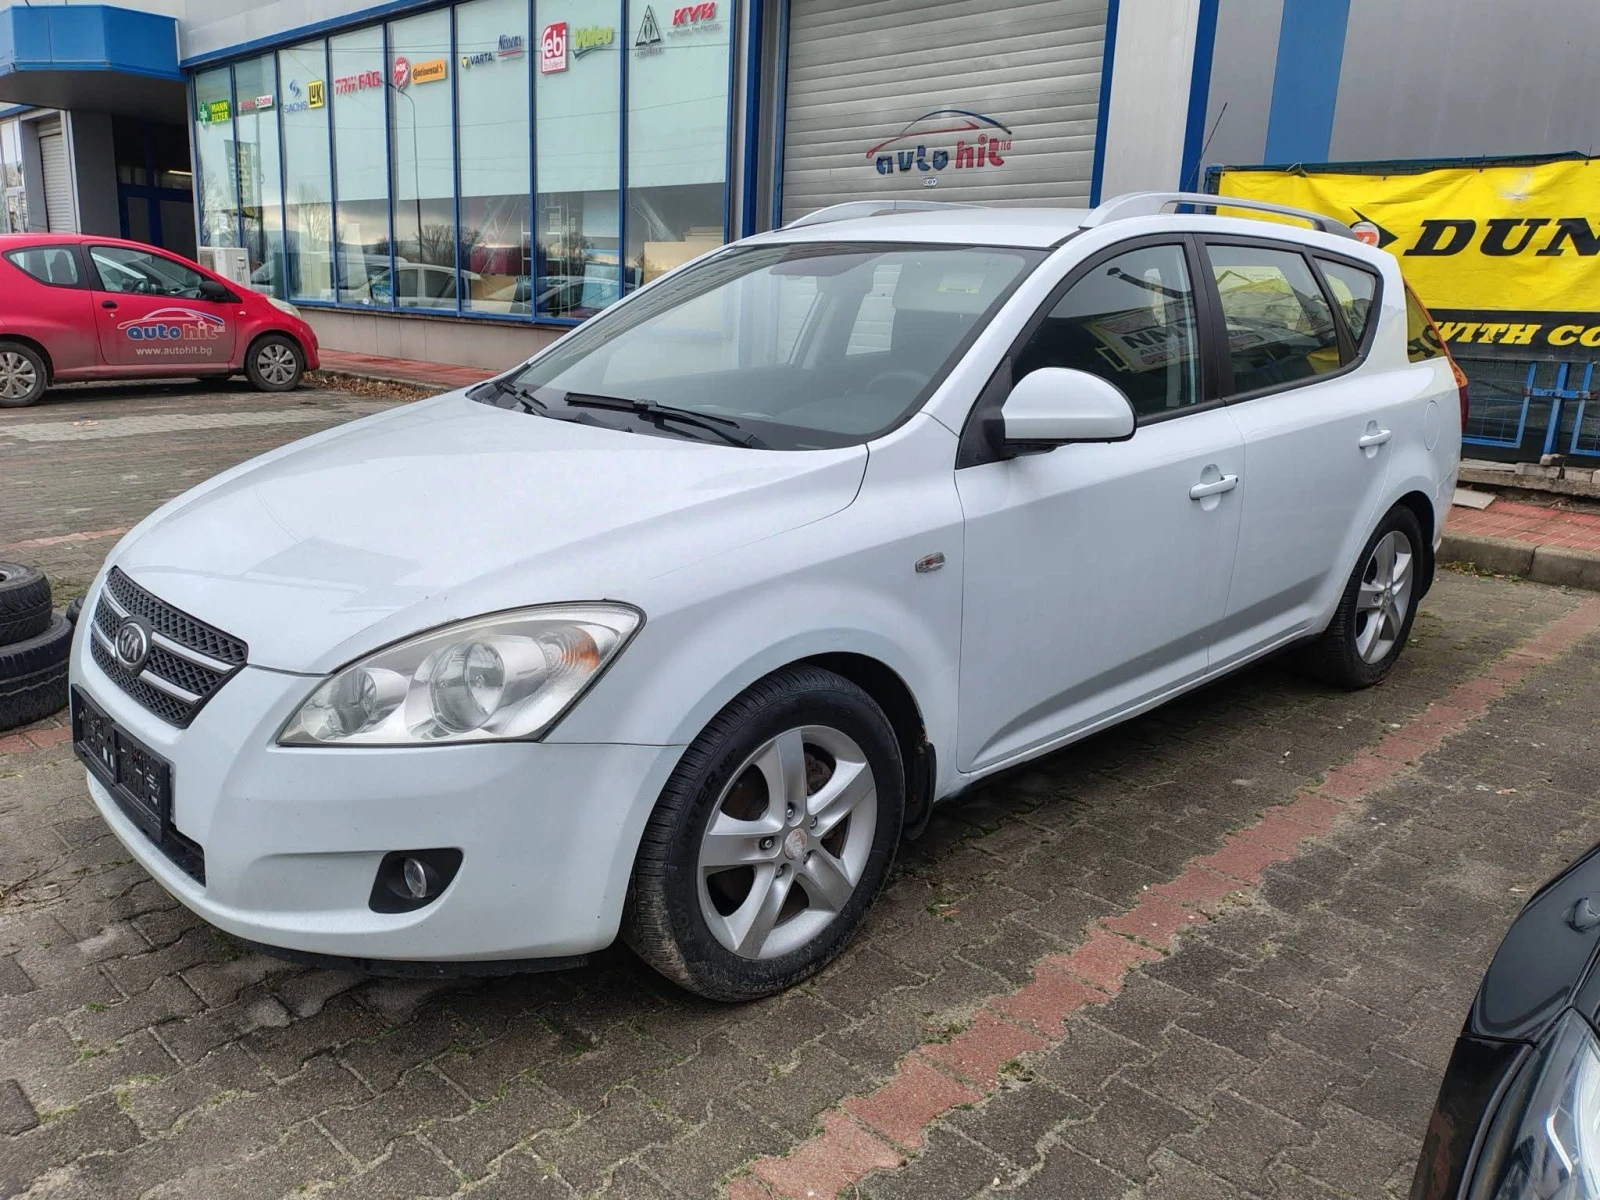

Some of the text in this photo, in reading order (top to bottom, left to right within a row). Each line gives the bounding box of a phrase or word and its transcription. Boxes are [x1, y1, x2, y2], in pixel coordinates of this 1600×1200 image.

[672, 2, 716, 26] KYB
[541, 25, 567, 58] febi
[470, 52, 493, 66] VARTA
[412, 64, 439, 80] Continental
[358, 71, 381, 91] FAG
[211, 101, 228, 113] MANN
[283, 100, 308, 114] SACHS
[211, 111, 229, 123] FILTER
[135, 345, 213, 356] www.autohit.bg
